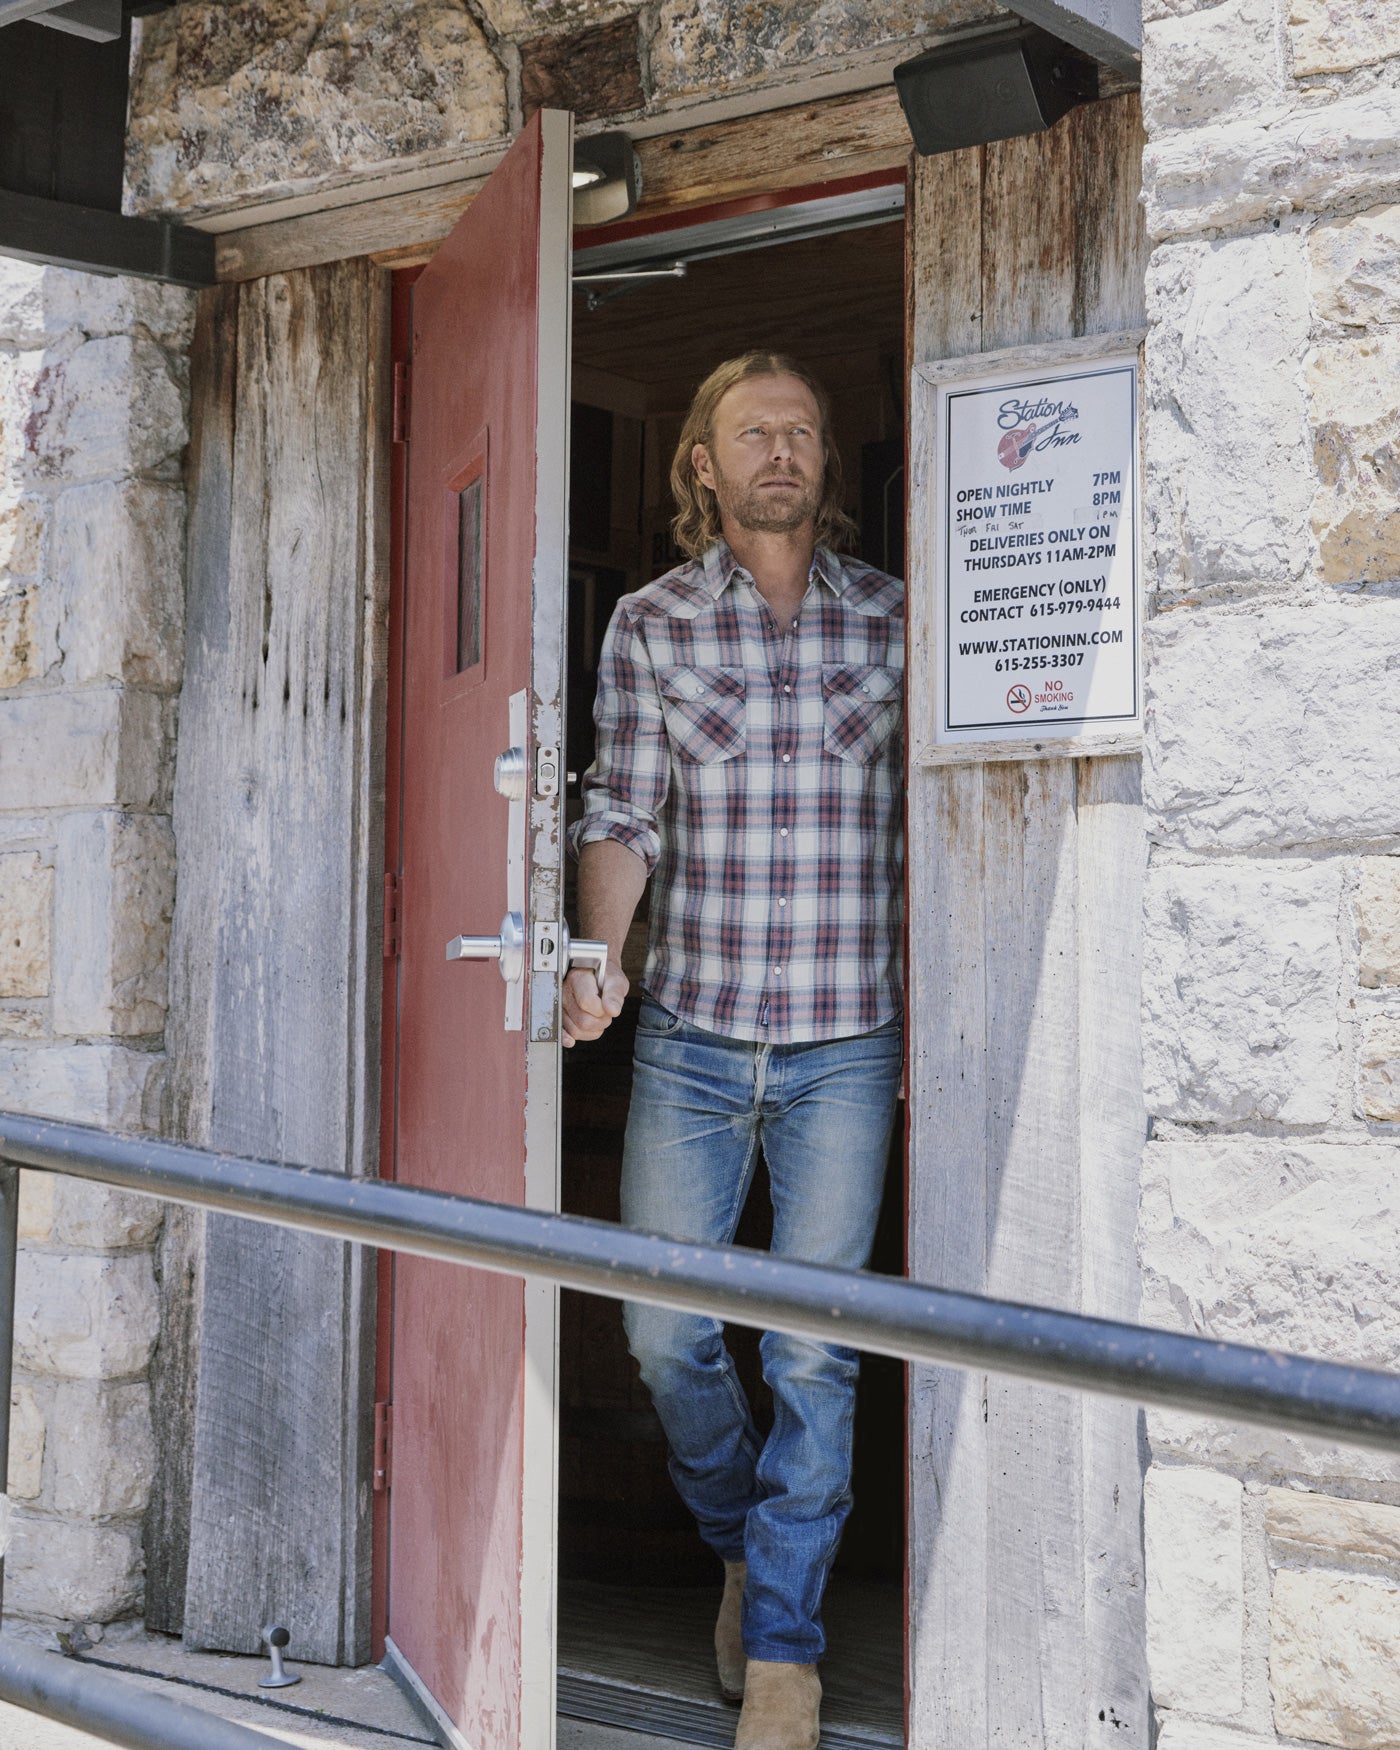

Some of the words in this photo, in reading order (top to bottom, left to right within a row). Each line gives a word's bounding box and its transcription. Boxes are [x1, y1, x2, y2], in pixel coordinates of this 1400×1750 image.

[997, 397, 1064, 430] Station
[1035, 423, 1082, 451] Inn
[1092, 471, 1121, 486] 7PM
[956, 486, 993, 502] OPEN
[996, 479, 1054, 499] NIGHTLY
[1092, 490, 1121, 506] 8PM
[956, 505, 996, 522] SHOW
[1000, 501, 1032, 516] TIME
[1008, 522, 1025, 531] SAT
[969, 532, 1044, 552] DELIVERIES
[1047, 529, 1085, 543] ONLY
[1088, 525, 1110, 539] ON
[964, 551, 1042, 572] THURSDAYS
[1046, 543, 1117, 563] 11AM-2PM
[974, 583, 1055, 603] EMERGENCY
[1058, 575, 1106, 597] (ONLY)
[960, 606, 1024, 623] CONTACT
[1030, 597, 1121, 617] 615-979-9444
[959, 630, 1123, 655] WWW.STATIONINN.COM
[995, 652, 1085, 672] 615-255-3307
[1044, 680, 1064, 691] NO
[1034, 692, 1074, 704] SMOKING
